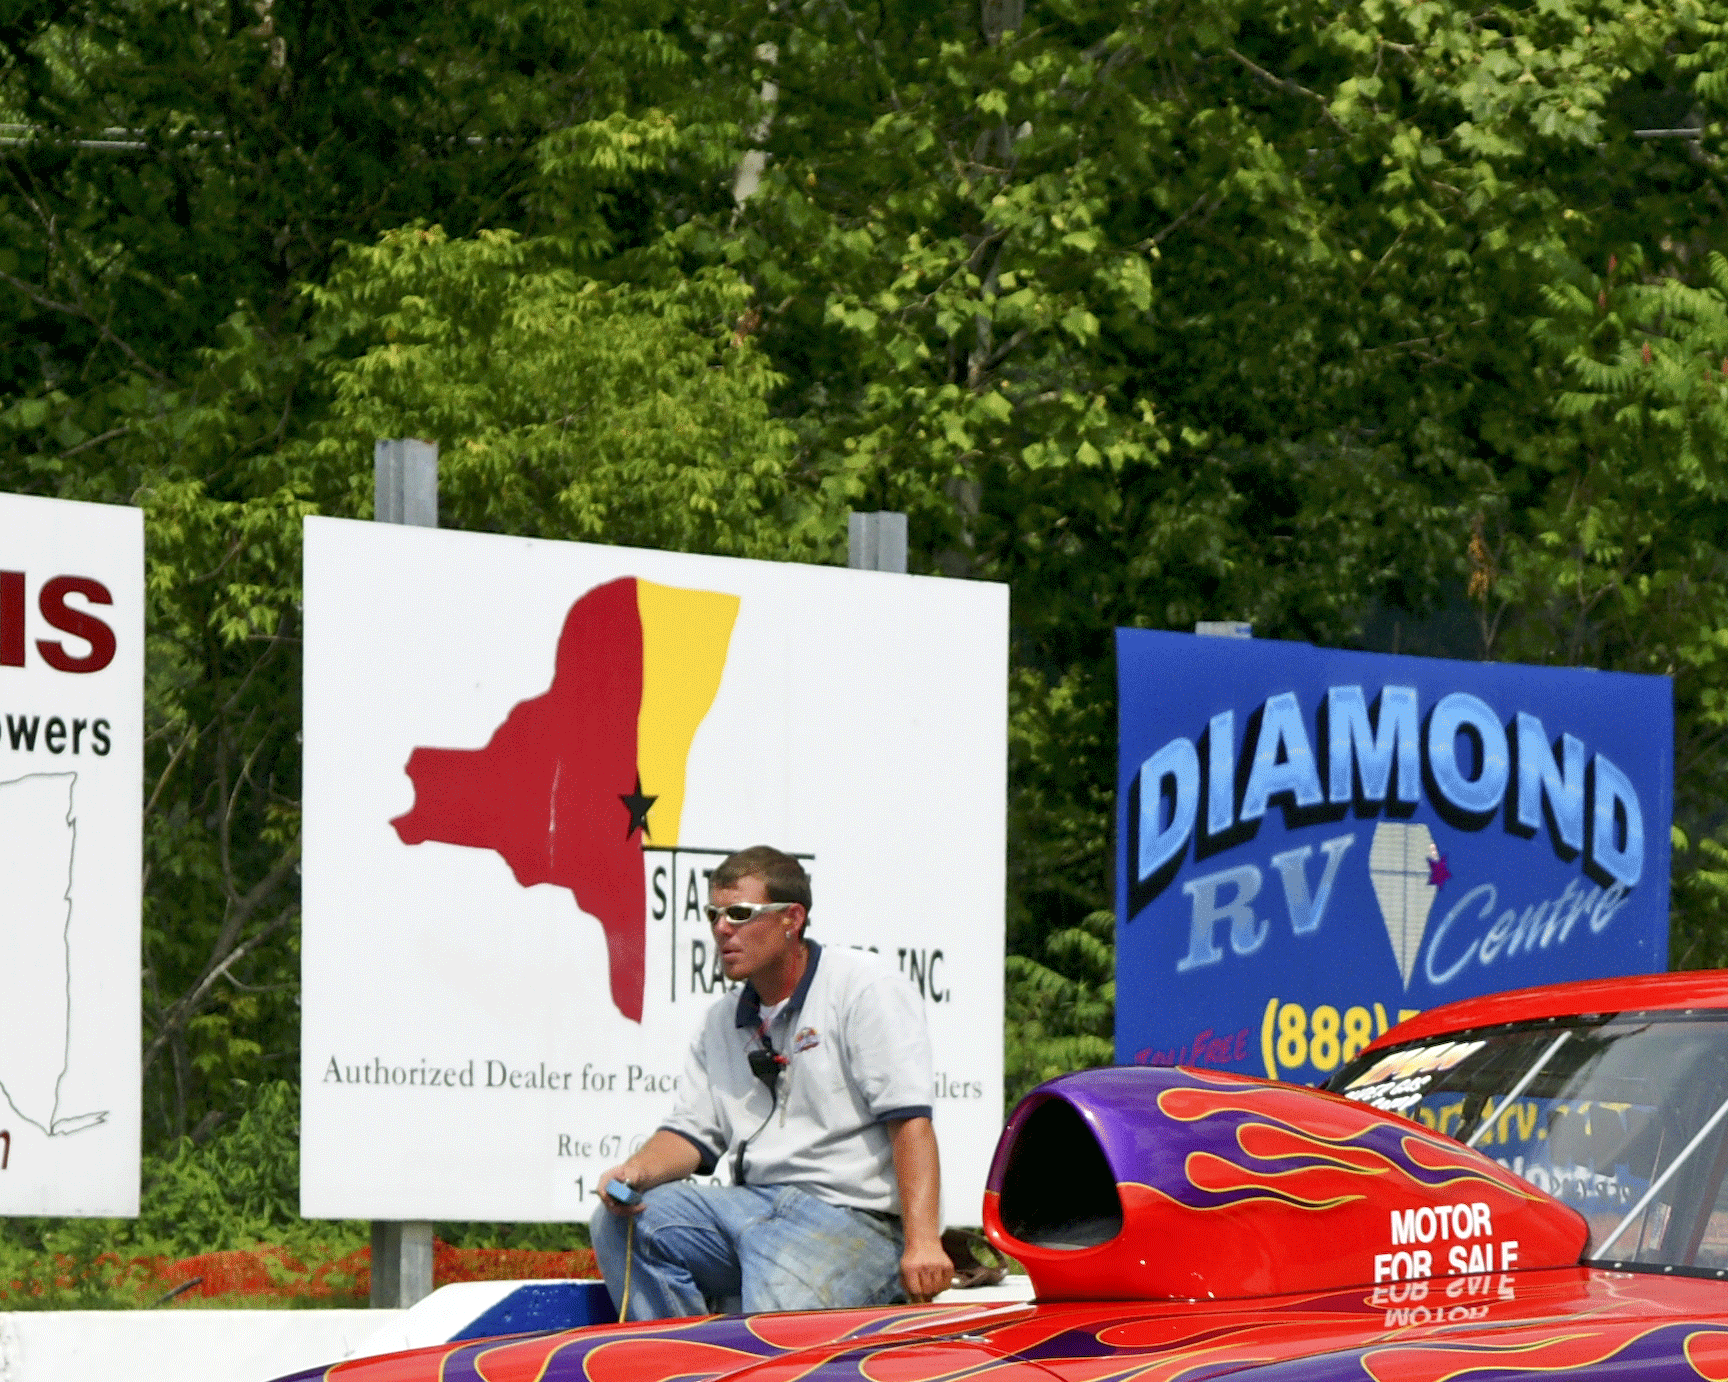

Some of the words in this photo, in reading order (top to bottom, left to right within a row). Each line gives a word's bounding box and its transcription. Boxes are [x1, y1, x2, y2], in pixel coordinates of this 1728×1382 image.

[0, 713, 111, 757] wers
[1128, 685, 1645, 920] DIAMOND
[1176, 833, 1355, 973] RV
[1425, 877, 1628, 985] Centre
[323, 1055, 474, 1087] Authorized
[485, 1059, 572, 1091] Dealer
[582, 1062, 616, 1092] for
[558, 1133, 592, 1158] Rte
[599, 1134, 621, 1158] 67
[1391, 1202, 1493, 1246] MOTOR
[1374, 1250, 1433, 1284] FOR
